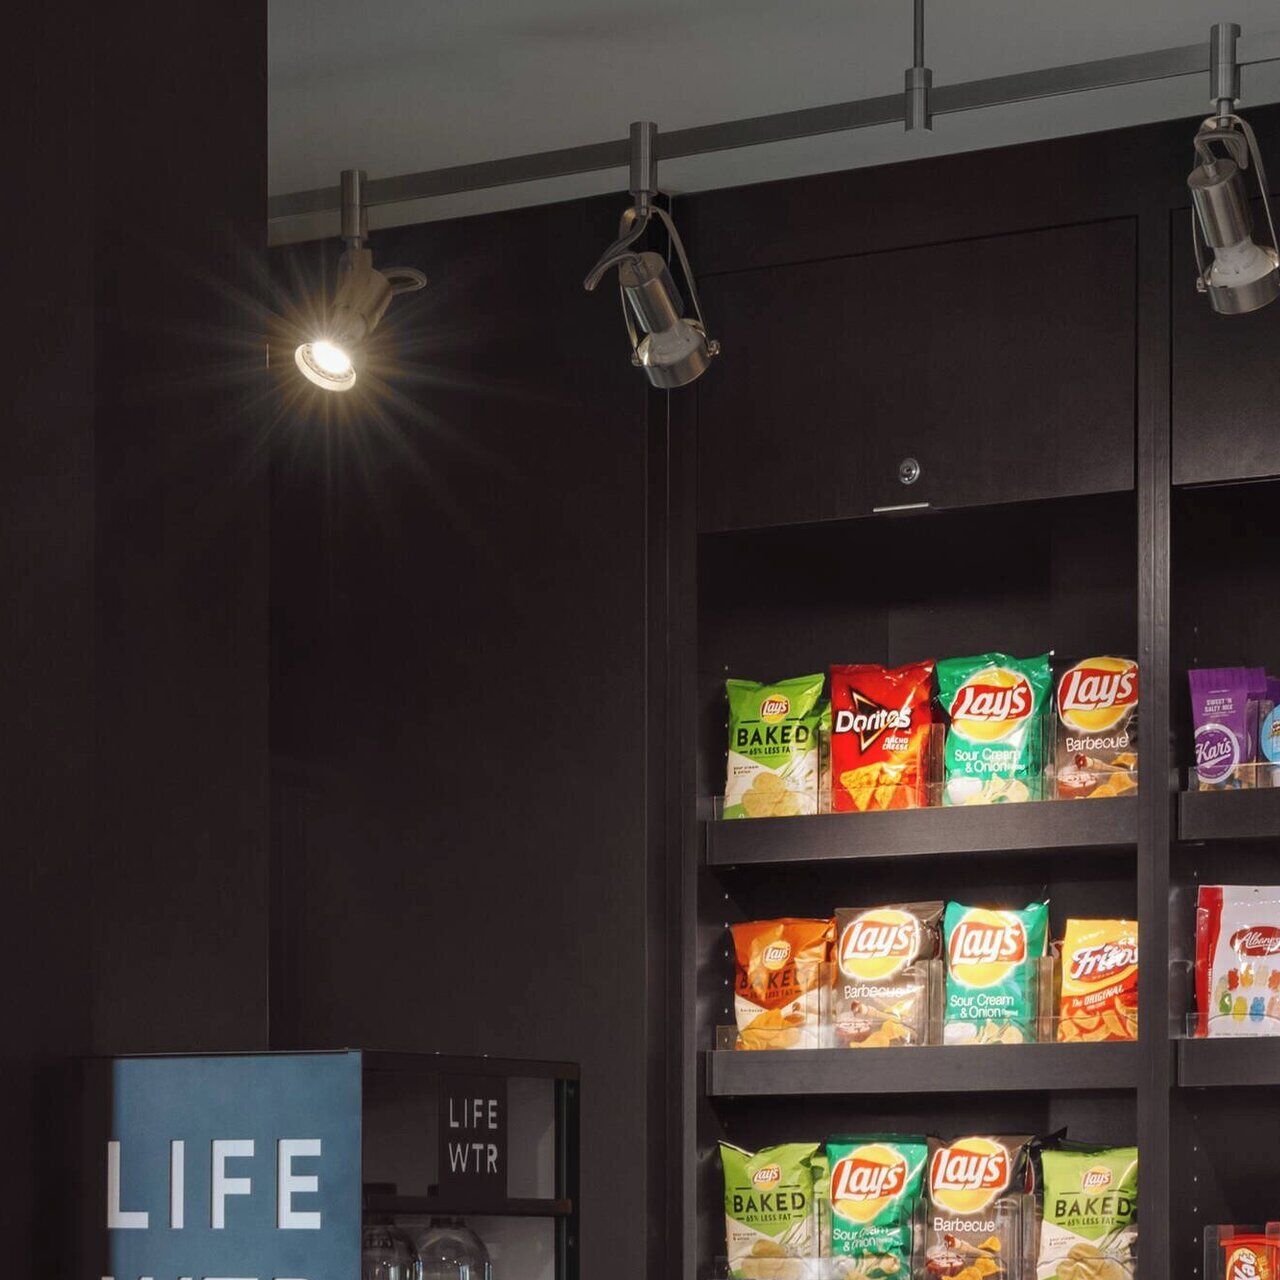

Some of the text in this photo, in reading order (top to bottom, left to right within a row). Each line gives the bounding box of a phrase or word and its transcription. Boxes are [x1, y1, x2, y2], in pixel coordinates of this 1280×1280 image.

[1064, 667, 1136, 710] Lay's
[953, 685, 1028, 720] Lay's
[835, 707, 911, 733] Doritos
[737, 726, 809, 746] BAKED
[1066, 735, 1128, 752] Barbecue
[954, 750, 978, 761] Sour
[966, 762, 972, 772] &
[974, 760, 1006, 772] Onion
[844, 922, 913, 959] Lay's
[952, 924, 1020, 965] Lay's
[950, 994, 1014, 1006] Sour Cream
[960, 1008, 967, 1018] &
[969, 1006, 1002, 1018] Onion
[450, 1098, 498, 1129] LIFE
[448, 1143, 498, 1174] WTR
[835, 1161, 903, 1200] Lay's
[934, 1150, 1004, 1190] Lay's
[107, 1138, 321, 1229] LIFE
[733, 1192, 806, 1213] BAKED
[1055, 1197, 1131, 1218] BAKED
[760, 1214, 776, 1222] LESS
[779, 1213, 791, 1221] FAT
[934, 1218, 995, 1232] Barbecue
[833, 1228, 857, 1240] Sour
[843, 1242, 850, 1251] &
